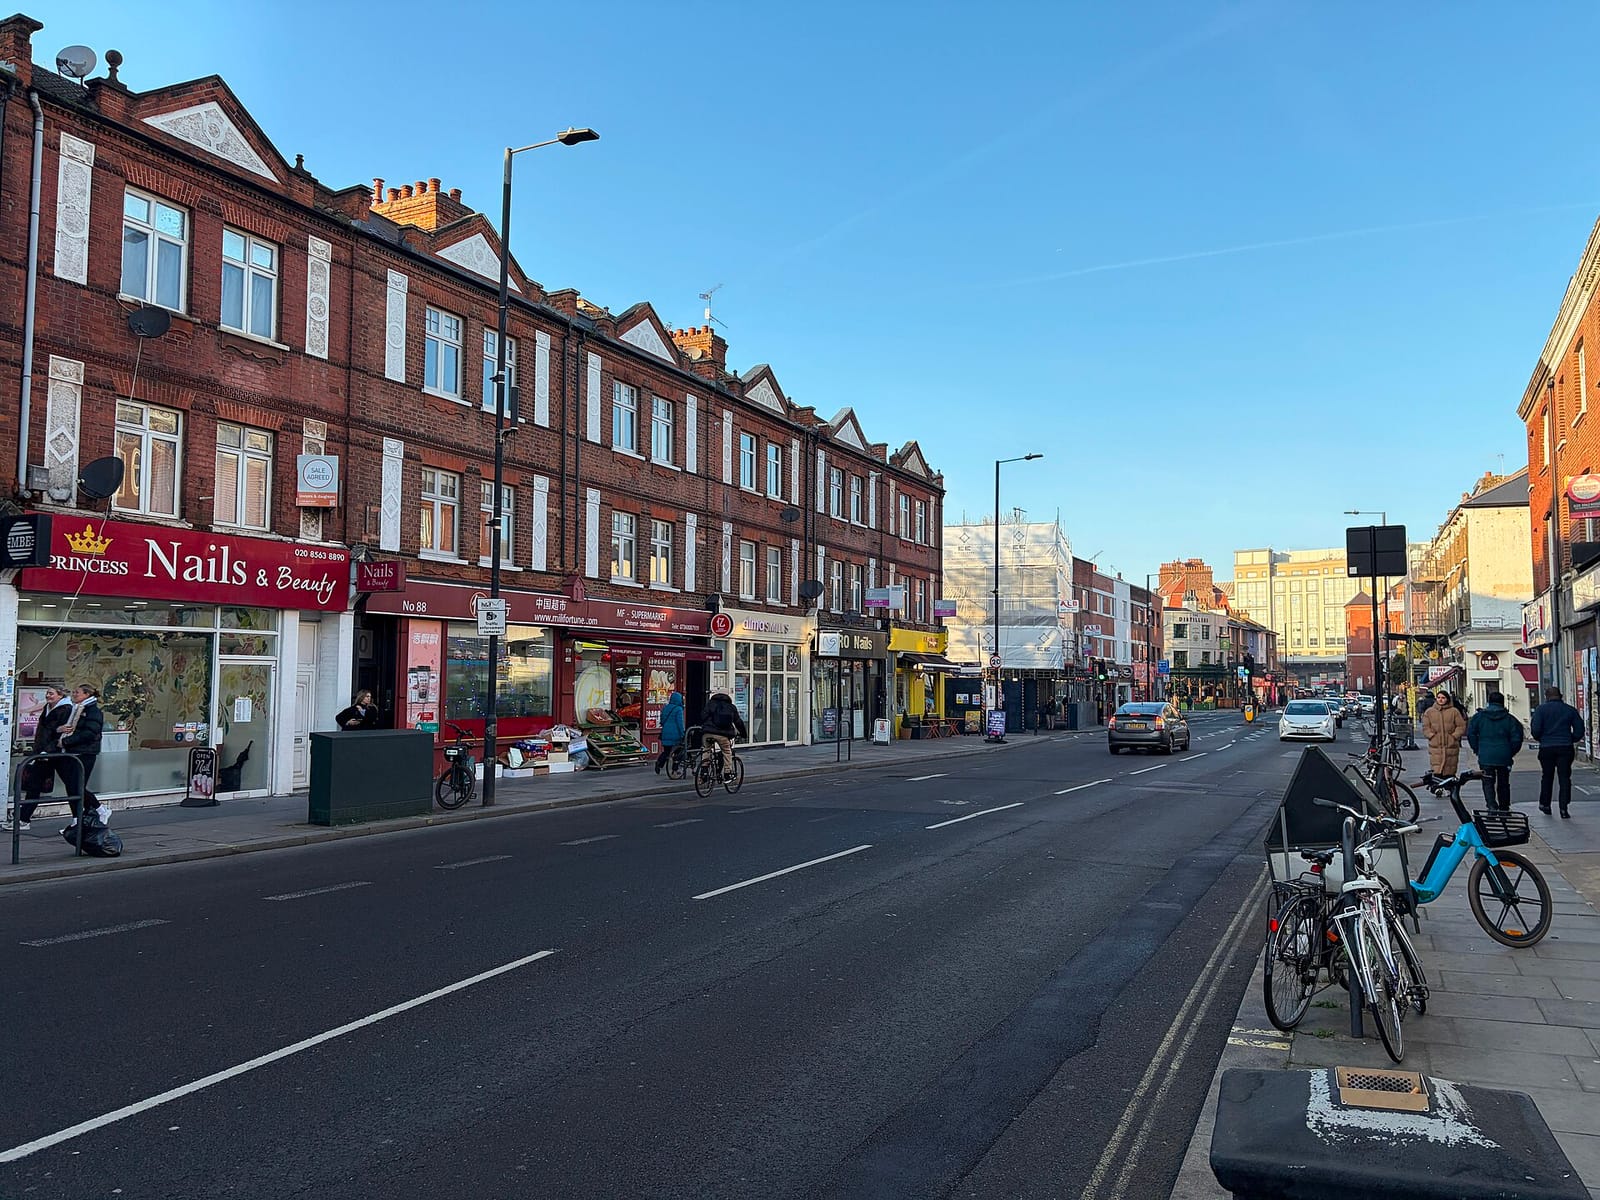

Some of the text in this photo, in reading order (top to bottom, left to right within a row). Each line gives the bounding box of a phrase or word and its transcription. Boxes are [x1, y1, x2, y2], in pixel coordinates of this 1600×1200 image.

[11, 535, 32, 548] MBE
[294, 549, 345, 562] 020 8563 8890
[143, 538, 337, 605] Nails & Beauty
[363, 563, 394, 578] Nails
[402, 600, 427, 613] No 88
[535, 596, 567, 611] 中国超市
[616, 608, 626, 617] MF
[631, 610, 667, 622] SUPERMARKET
[853, 635, 873, 650] Nails
[789, 651, 798, 665] 86
